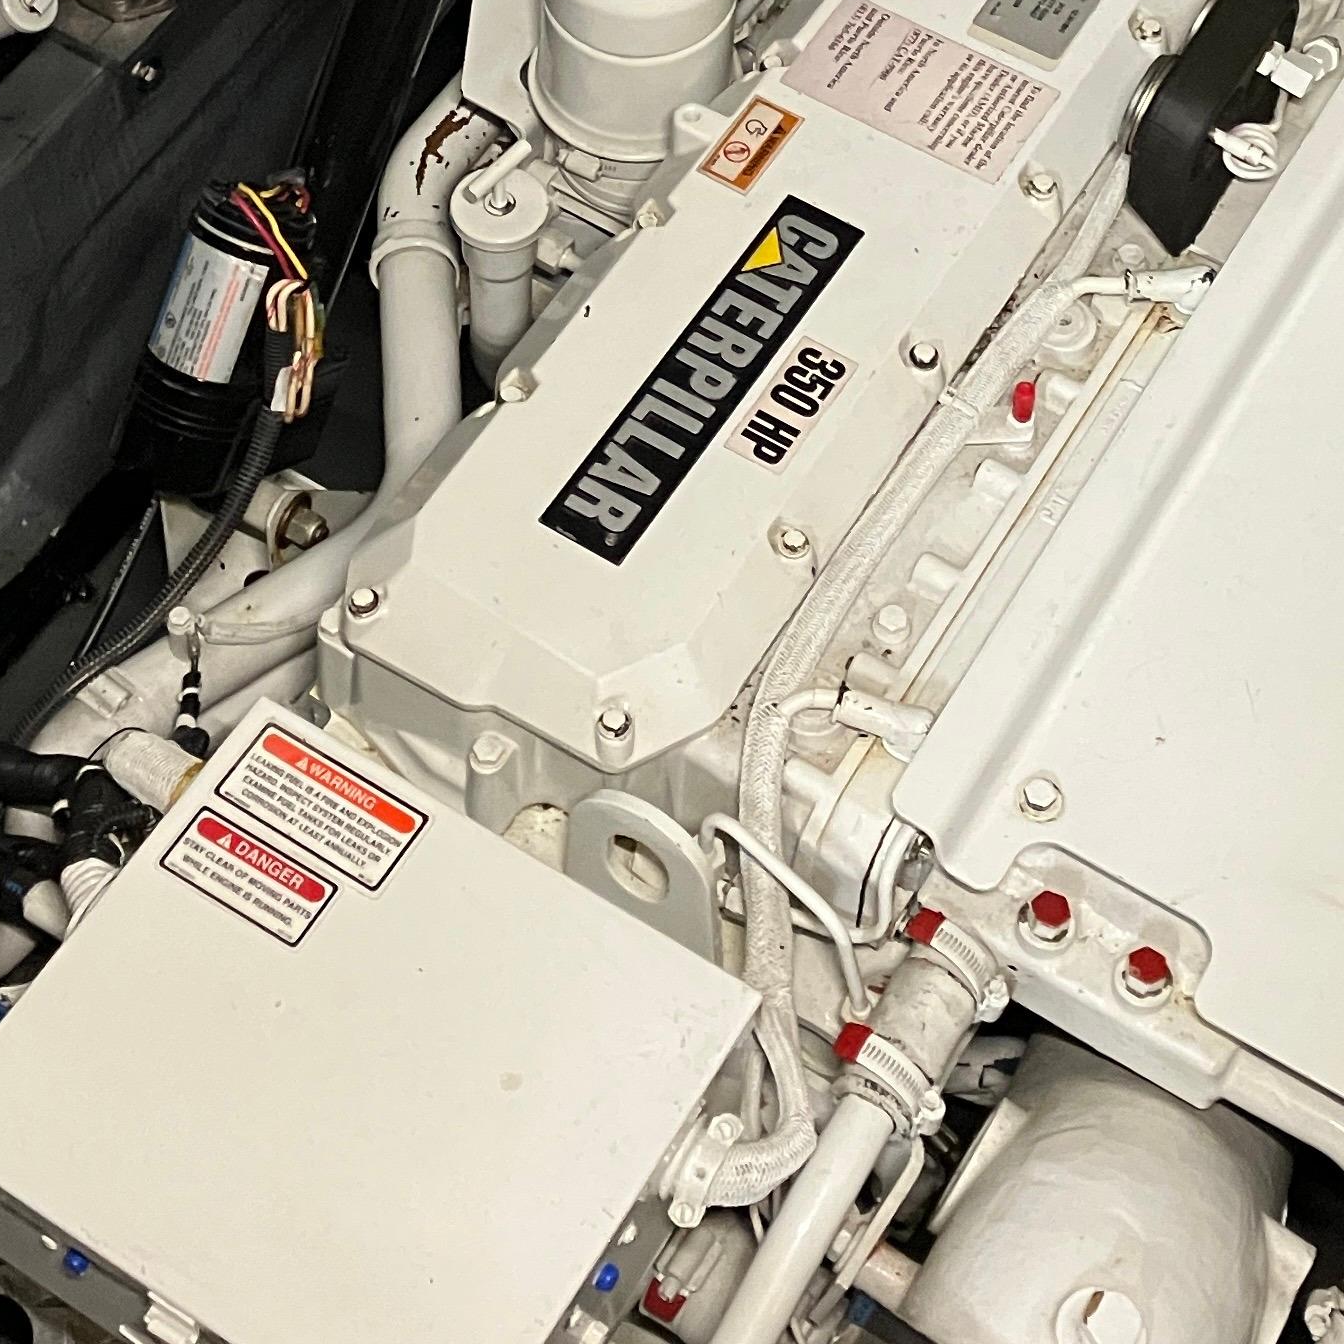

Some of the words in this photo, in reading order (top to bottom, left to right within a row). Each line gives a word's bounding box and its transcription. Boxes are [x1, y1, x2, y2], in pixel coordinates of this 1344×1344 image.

[564, 214, 839, 534] CATERPILLAR
[771, 347, 846, 417] 350
[741, 409, 801, 465] HP
[277, 782, 313, 808] INSPECT
[310, 803, 345, 828] SYSTEM
[305, 761, 379, 811] WARNING
[275, 794, 298, 812] FUEL
[296, 807, 325, 829] TANKS
[322, 823, 342, 839] FOR
[339, 834, 369, 856] LEAKS
[366, 850, 382, 864] OR
[285, 815, 299, 827] AT
[296, 821, 326, 843] LEAST
[337, 805, 358, 821] AND
[181, 836, 206, 855] STAY
[203, 849, 236, 873] CLEAR
[233, 868, 249, 881] OF
[246, 876, 283, 902] MOVING
[281, 897, 313, 920] PARTS
[208, 870, 243, 895] ENGINE
[241, 890, 253, 901] IS
[232, 839, 306, 891] DANGER
